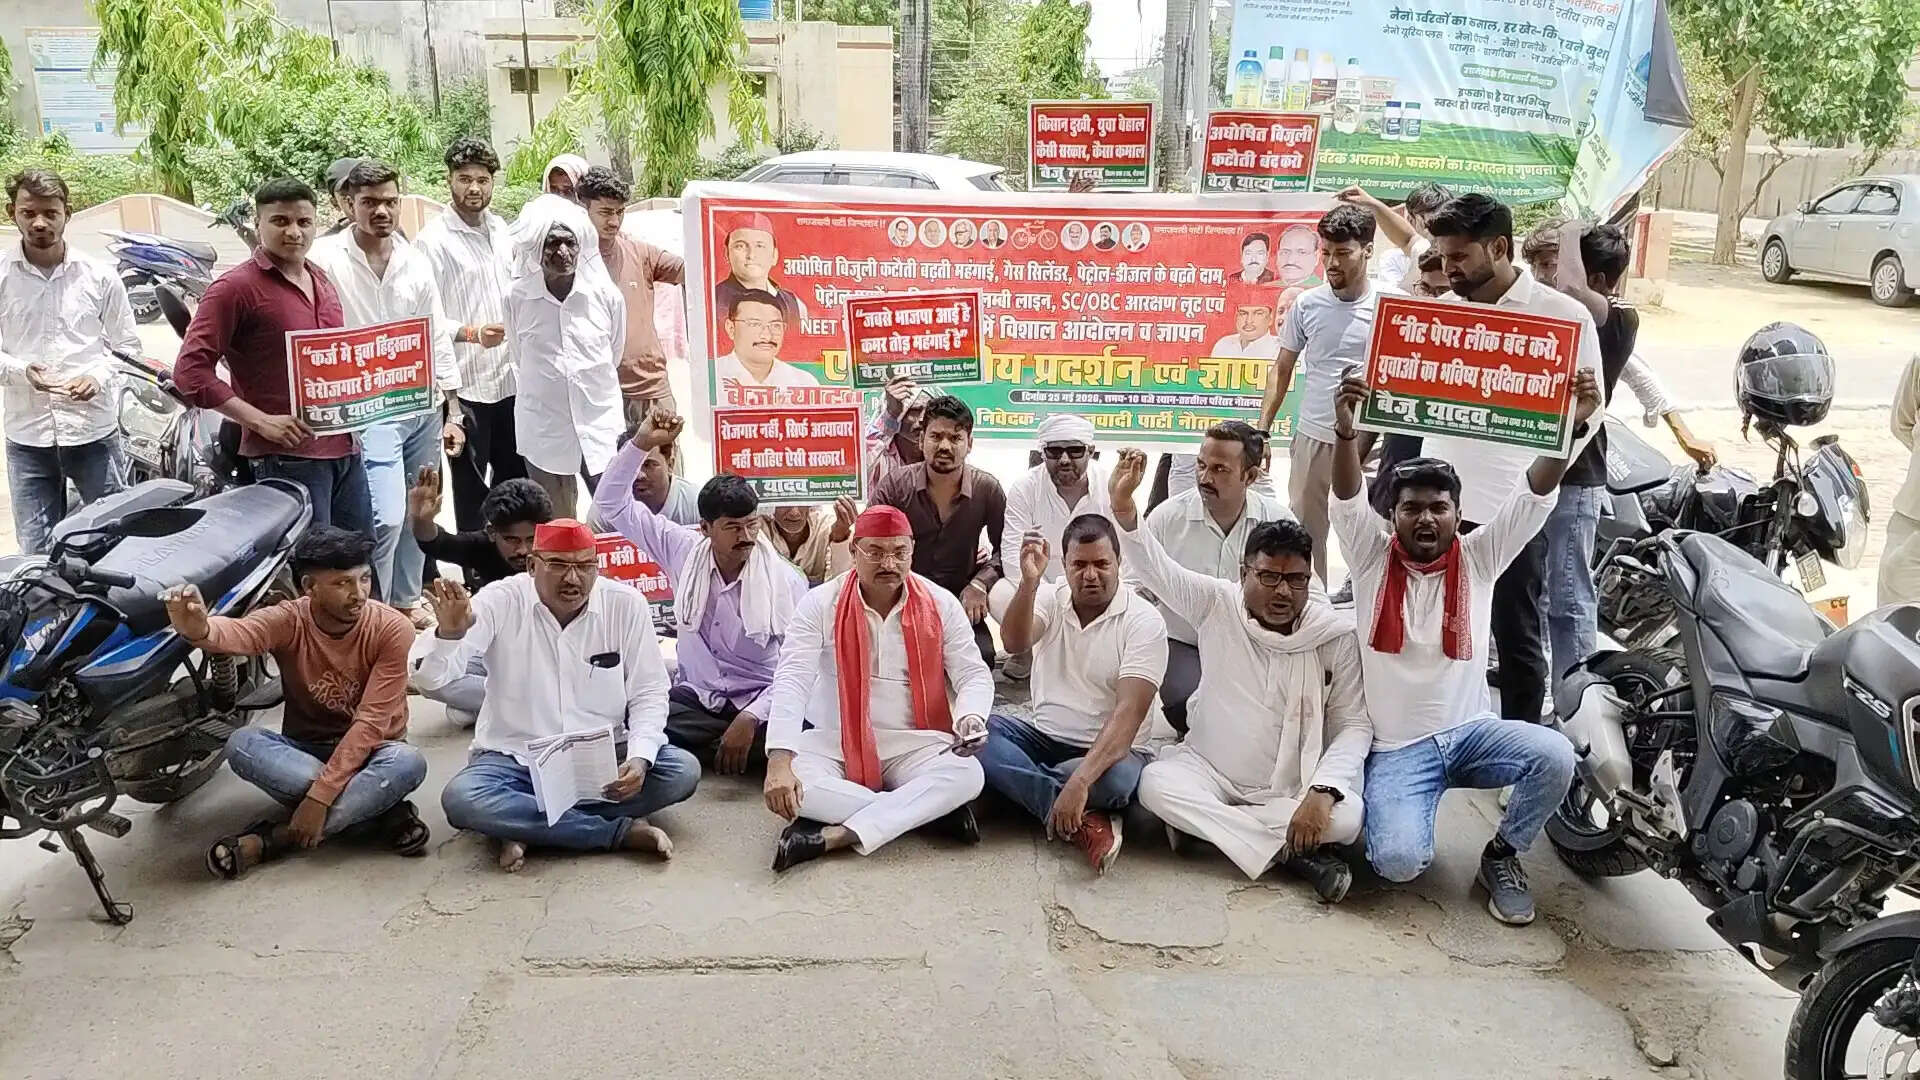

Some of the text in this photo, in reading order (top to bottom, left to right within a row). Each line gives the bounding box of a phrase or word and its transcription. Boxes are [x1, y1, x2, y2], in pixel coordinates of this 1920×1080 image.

[783, 255, 833, 277] अघोषित
[1154, 263, 1167, 283] के
[961, 301, 972, 322] है
[1061, 291, 1122, 313] SC/OBC
[1124, 294, 1179, 314] आरक्षण
[1204, 291, 1228, 314] एवं
[800, 318, 838, 336] NEET
[1062, 314, 1136, 342] आंदोलन
[1155, 321, 1207, 343] ज्ञापन
[1430, 317, 1463, 349] पेपर
[1464, 322, 1502, 353] लीक
[1503, 326, 1528, 357] बंद
[1529, 331, 1563, 367] करो,
[1032, 343, 1146, 388] प्रदर्शन
[1152, 357, 1189, 385] एवं
[1198, 357, 1300, 392] ज्ञाप
[1377, 352, 1421, 385] युवाओं
[1421, 359, 1438, 383] का
[1440, 357, 1480, 389] भविष्य
[1480, 363, 1526, 399] सुरक्षित
[362, 370, 372, 392] है
[1137, 411, 1174, 430] पार्टी
[1425, 400, 1491, 427] यादव
[721, 420, 759, 441] रोजगार
[731, 447, 751, 469] नहीं
[762, 479, 809, 494] यादव
